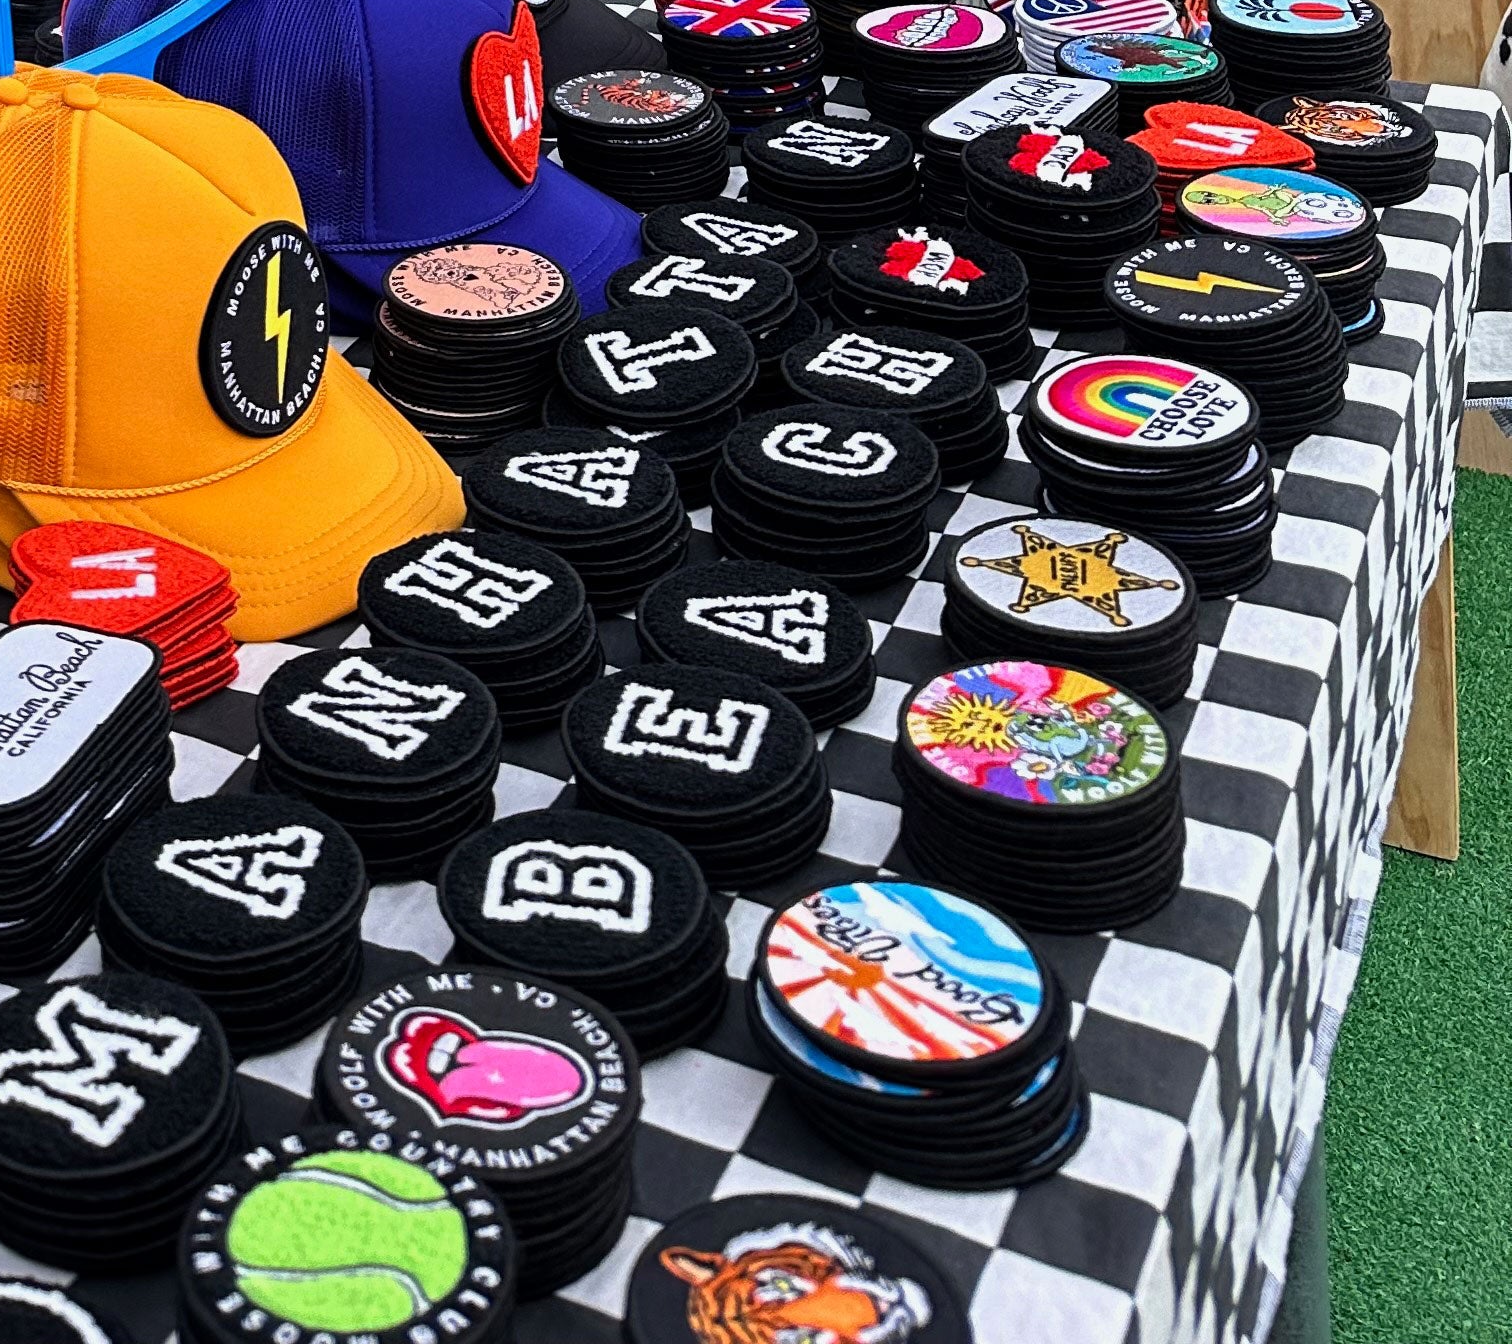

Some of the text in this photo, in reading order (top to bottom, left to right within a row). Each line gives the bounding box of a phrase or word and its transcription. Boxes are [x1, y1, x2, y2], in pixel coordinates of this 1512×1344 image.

[503, 58, 539, 142] LA
[767, 120, 892, 168] N
[1042, 145, 1078, 170] DAD
[1173, 121, 1260, 156] LA
[496, 247, 520, 257] CA
[681, 212, 799, 257] A
[1223, 241, 1251, 254] CA
[226, 233, 320, 317] MOOSE WITH ME
[391, 275, 428, 307] MOOSE
[628, 255, 757, 303] T
[916, 251, 954, 285] MOM
[1114, 238, 1197, 314] MOOSE WITH ME
[443, 290, 556, 317] MANHATTAN
[1178, 291, 1301, 323] MANHATTAN
[220, 340, 281, 425] MANHATTAN
[315, 302, 325, 333] CA
[584, 326, 718, 396] T
[1139, 379, 1220, 442] CHOOSE
[1176, 397, 1238, 440] LOVE
[504, 447, 640, 509] A
[761, 421, 899, 478] C
[69, 546, 157, 600] LA
[384, 538, 554, 629] H
[685, 589, 830, 665] A
[18, 631, 104, 693] Beach
[6, 678, 93, 757] CALIFORNIA
[287, 656, 467, 761] N
[603, 682, 772, 774] E
[1061, 768, 1148, 803] WOOLF
[154, 824, 325, 920] A
[482, 838, 653, 934] B
[800, 893, 1026, 1028] Good Vibes
[514, 981, 559, 1009] CA
[339, 972, 475, 1130] WOOLF WITH ME
[434, 1099, 622, 1169] MANHATTAN
